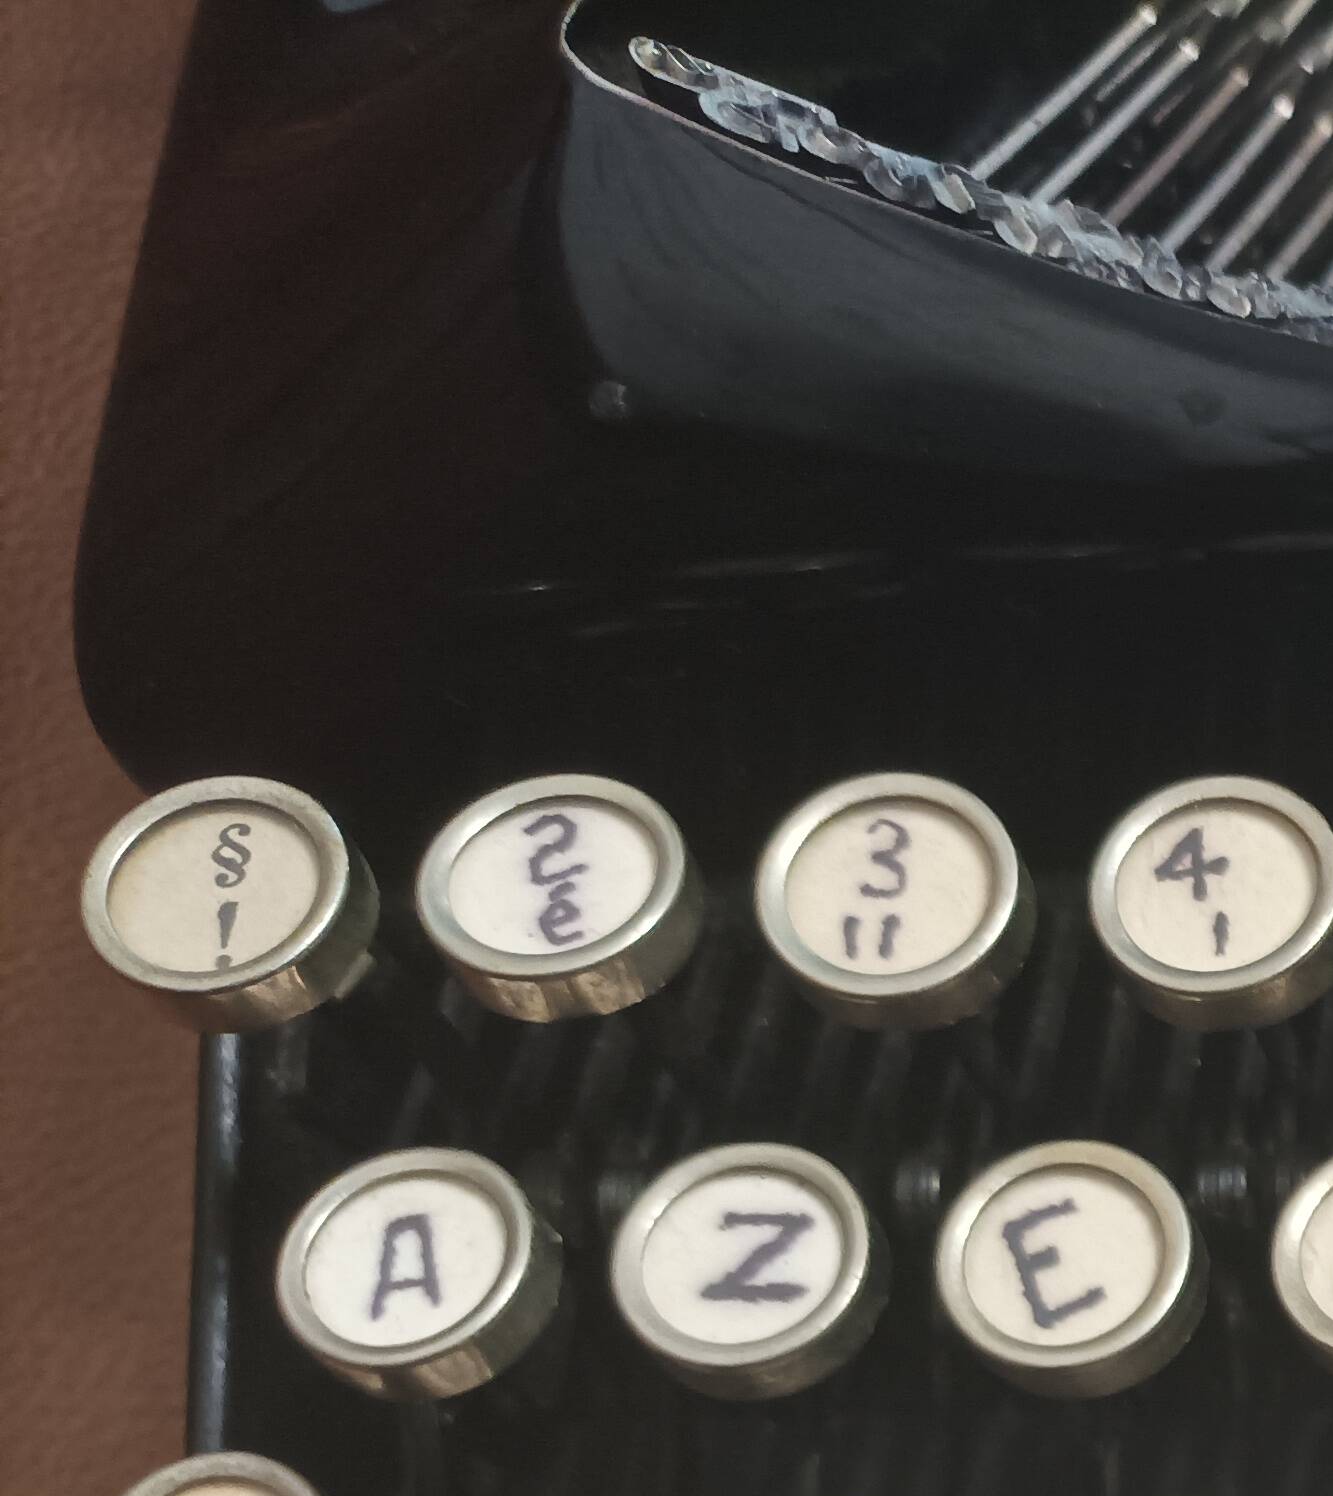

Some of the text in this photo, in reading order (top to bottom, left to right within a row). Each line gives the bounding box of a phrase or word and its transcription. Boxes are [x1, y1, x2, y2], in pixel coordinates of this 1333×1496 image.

[211, 823, 251, 888] §
[520, 810, 592, 877] 2
[859, 819, 910, 899] 3
[1154, 828, 1229, 902] 4
[538, 881, 585, 945] é
[369, 1214, 441, 1321] A
[700, 1211, 814, 1303] Z
[1002, 1198, 1106, 1329] E
